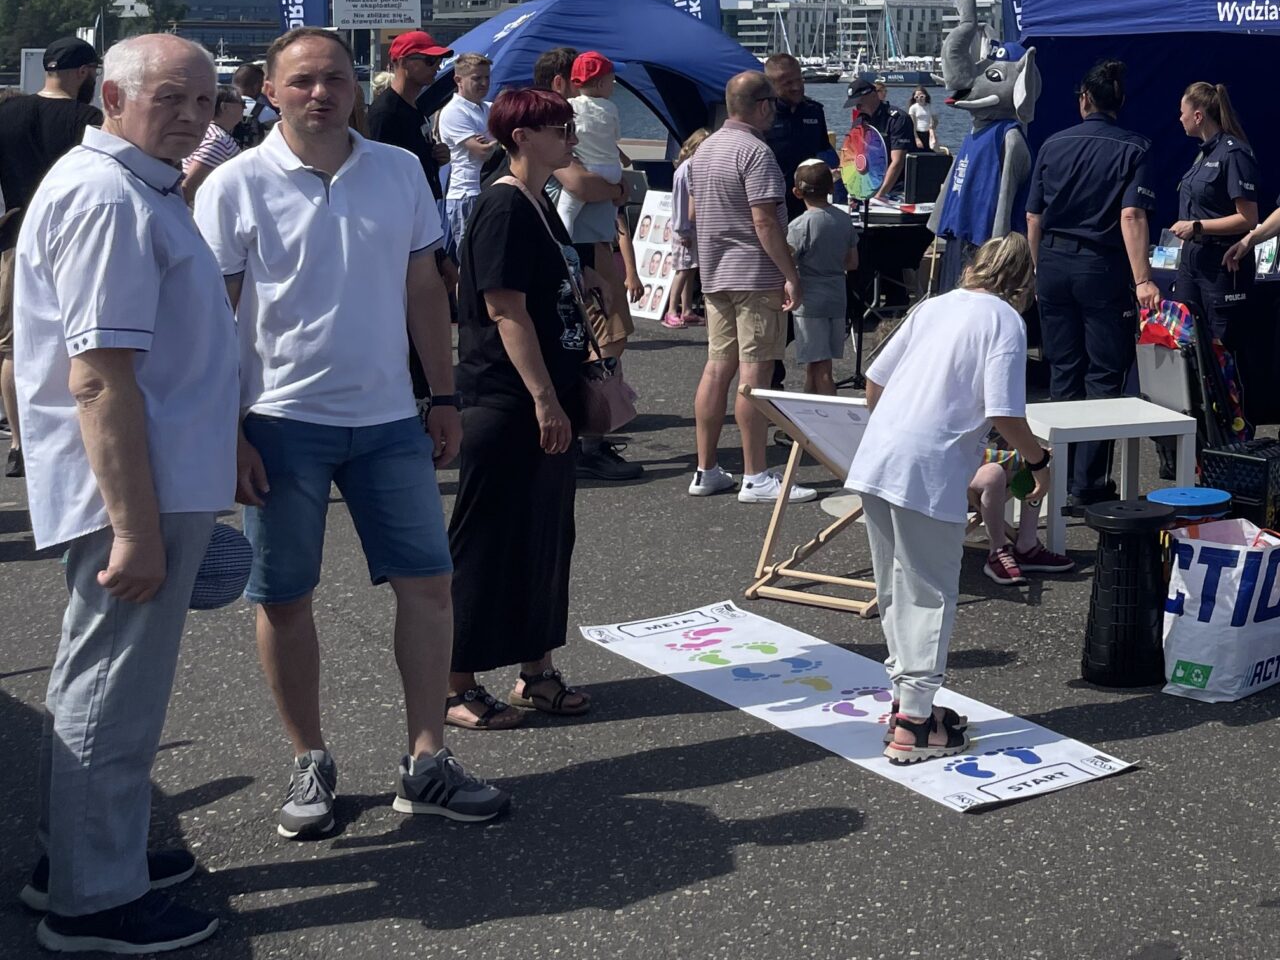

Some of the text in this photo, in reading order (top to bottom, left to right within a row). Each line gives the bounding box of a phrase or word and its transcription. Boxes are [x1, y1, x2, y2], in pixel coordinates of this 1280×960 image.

[1224, 292, 1247, 303] POLICJA
[644, 618, 696, 632] META
[1007, 770, 1070, 793] START
